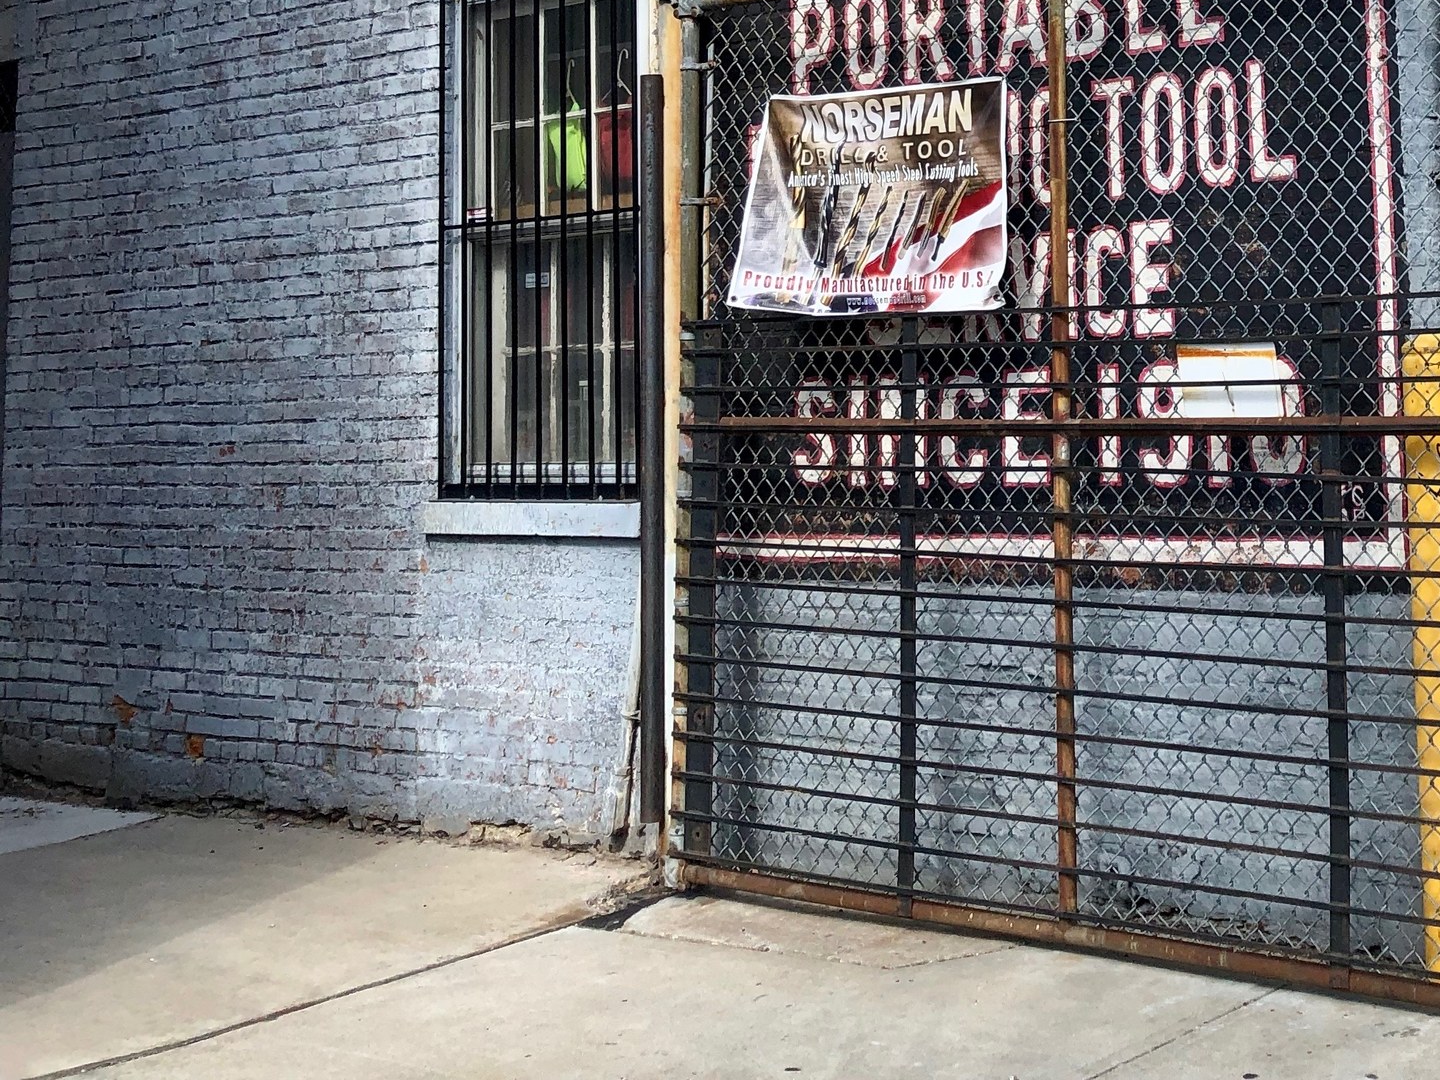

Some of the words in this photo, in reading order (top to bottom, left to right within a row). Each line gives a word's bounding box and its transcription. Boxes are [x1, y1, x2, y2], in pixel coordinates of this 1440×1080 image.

[801, 89, 973, 144] NORSEMAN
[1089, 59, 1298, 201] TOOL
[800, 147, 866, 166] DRILL
[876, 145, 889, 162] &
[902, 139, 968, 160] TOOL
[876, 164, 900, 187] Speed
[903, 161, 923, 182] Steel
[925, 160, 955, 183] Cutting
[957, 157, 979, 178] Tools
[743, 270, 814, 293] Proudly
[820, 273, 909, 293] Manufactured
[931, 271, 955, 290] the
[792, 365, 1053, 489] SINCE
